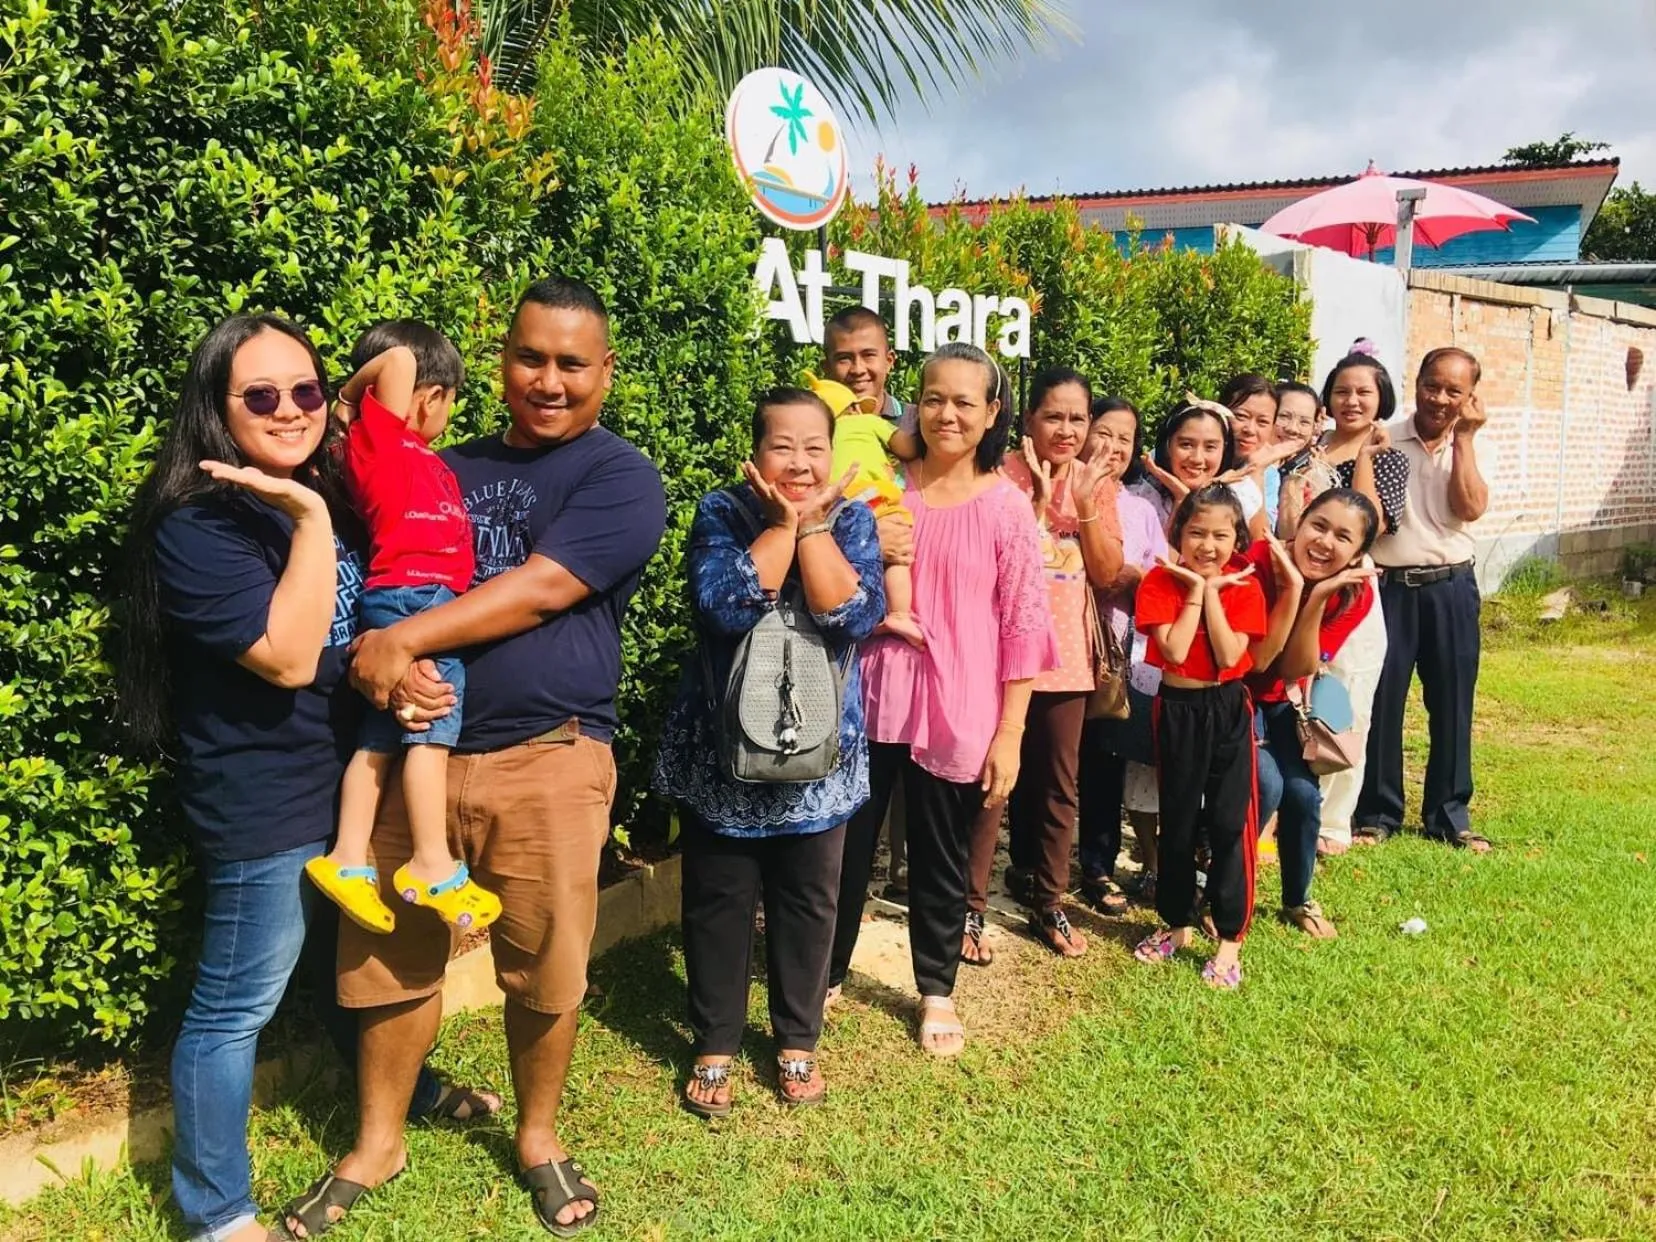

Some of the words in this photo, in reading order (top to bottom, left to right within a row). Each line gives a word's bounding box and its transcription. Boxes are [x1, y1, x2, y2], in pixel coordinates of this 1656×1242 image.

[752, 238, 831, 344] At
[845, 250, 1031, 358] Thara
[463, 481, 507, 512] BLUE
